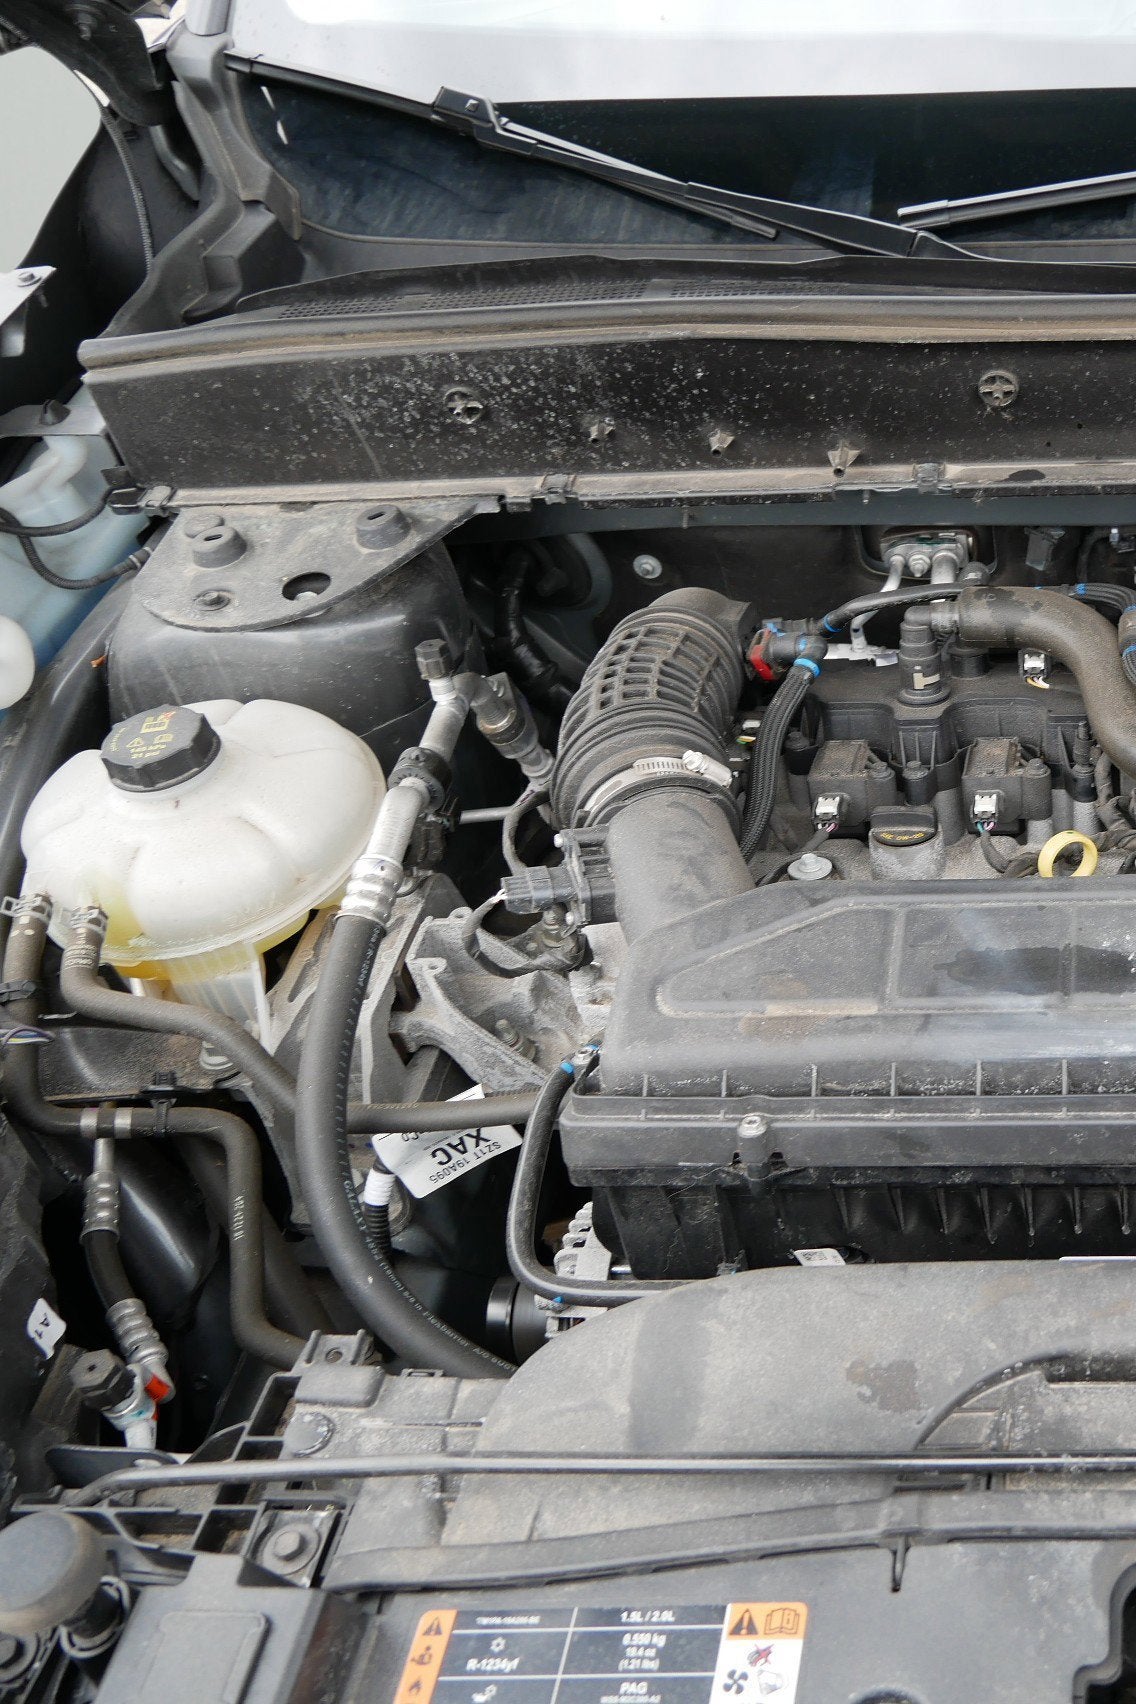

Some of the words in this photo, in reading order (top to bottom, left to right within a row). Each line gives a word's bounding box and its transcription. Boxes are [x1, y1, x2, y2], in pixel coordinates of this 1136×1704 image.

[431, 1127, 492, 1166] XAC
[429, 1159, 471, 1184] 19A095
[466, 1657, 520, 1674] R-1234yf
[619, 1681, 648, 1695] PAG
